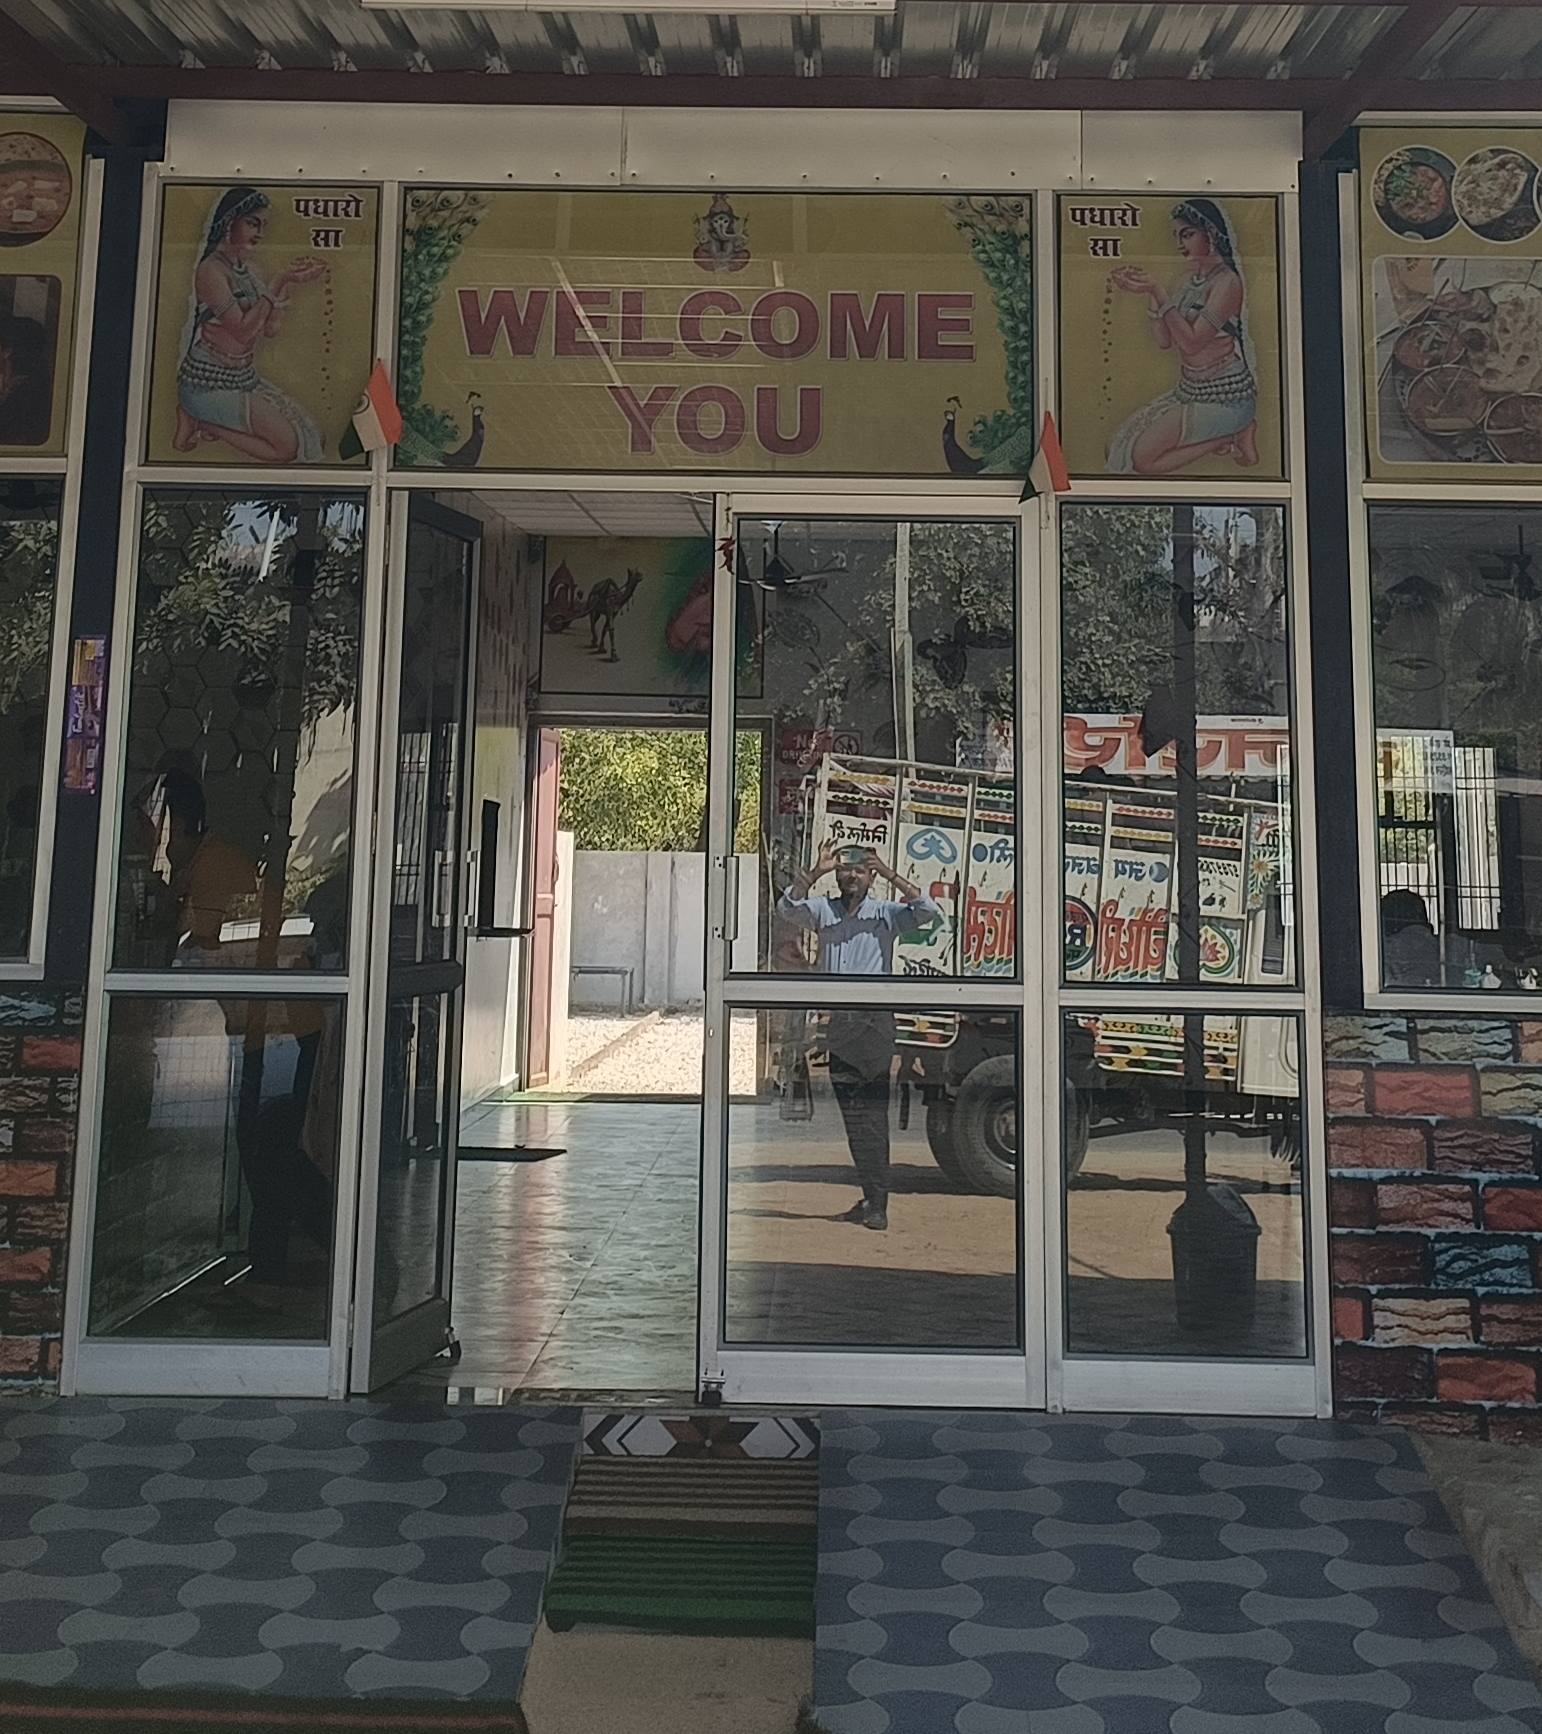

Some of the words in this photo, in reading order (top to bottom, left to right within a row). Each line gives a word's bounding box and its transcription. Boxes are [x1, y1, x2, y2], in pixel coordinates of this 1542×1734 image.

[293, 193, 365, 221] पधारो
[1069, 201, 1141, 229] पधारो
[310, 227, 343, 250] सा
[1088, 236, 1123, 259] सा
[455, 287, 977, 363] WELCOME
[607, 384, 824, 457] YOU
